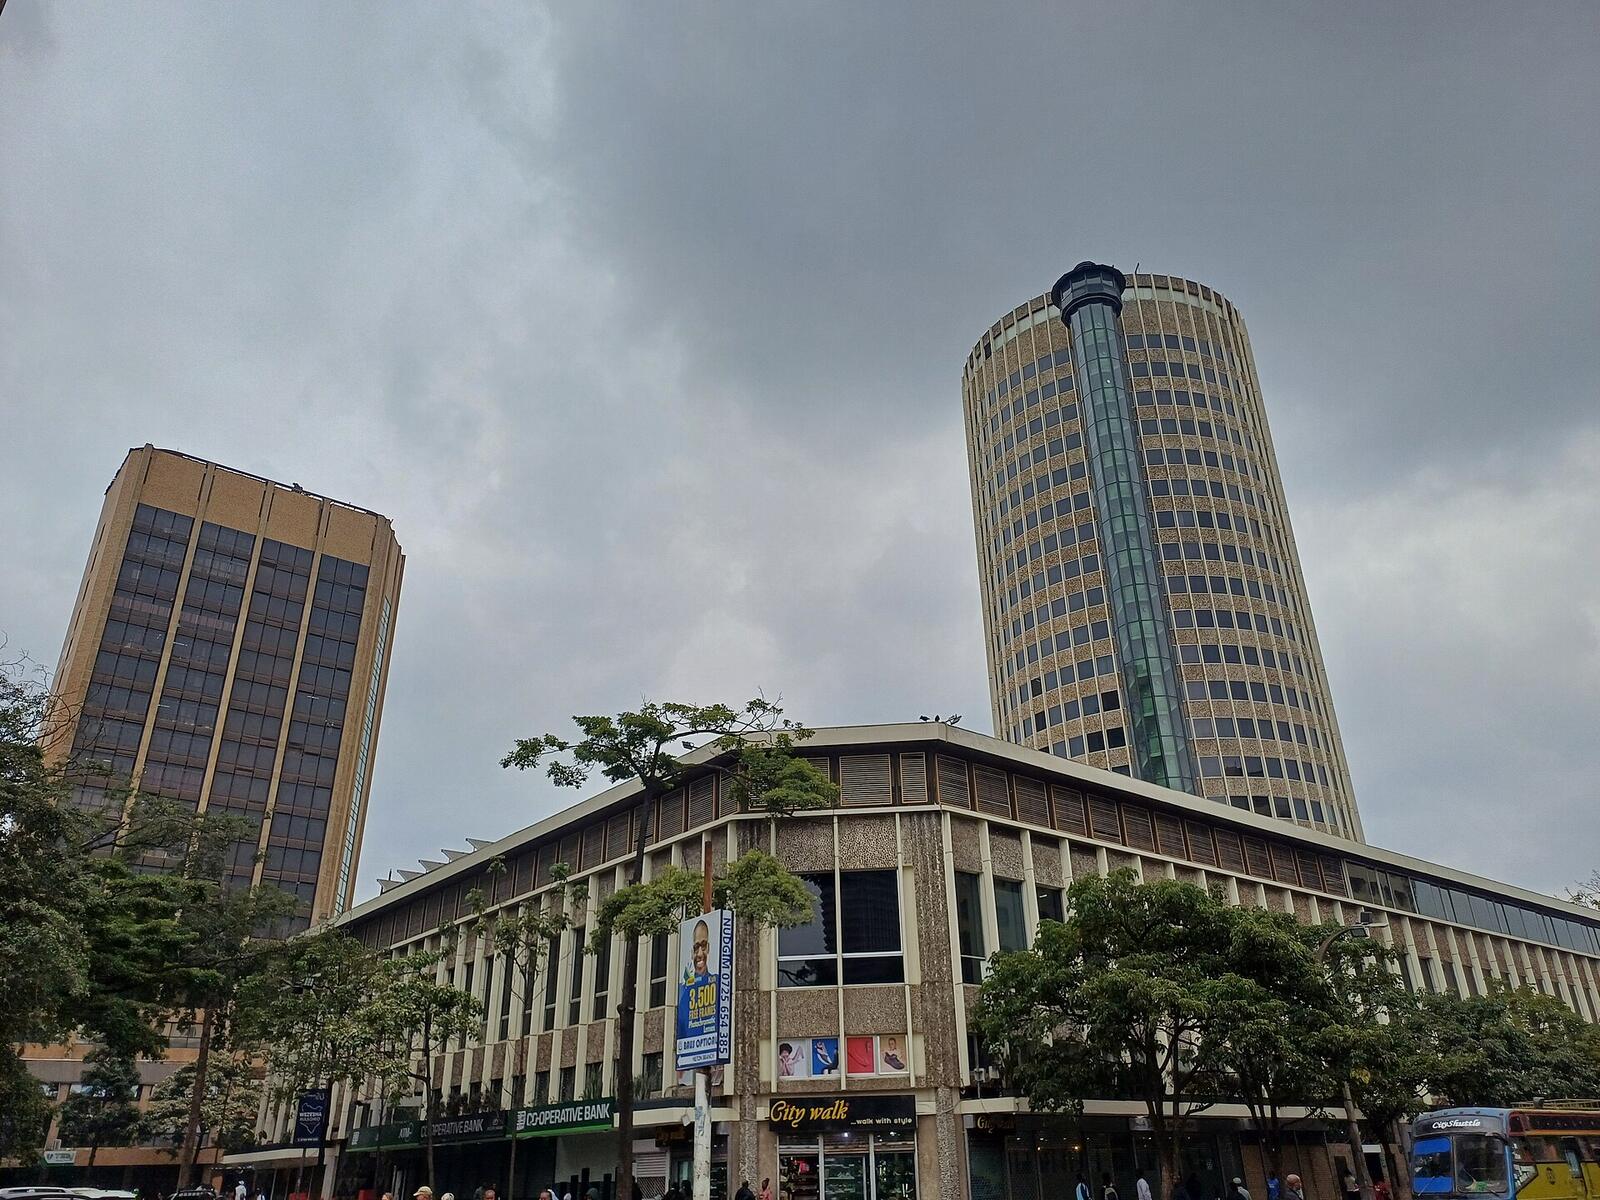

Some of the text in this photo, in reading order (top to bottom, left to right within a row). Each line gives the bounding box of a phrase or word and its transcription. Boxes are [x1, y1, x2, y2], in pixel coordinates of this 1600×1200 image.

[689, 982, 717, 1010] 3,500
[719, 917, 732, 1054] NUDGIM 0725 654 385
[584, 1103, 610, 1121] BANK
[770, 1099, 849, 1128] City walk
[875, 1116, 892, 1125] with
[893, 1116, 913, 1127] style
[463, 1118, 484, 1133] BANK
